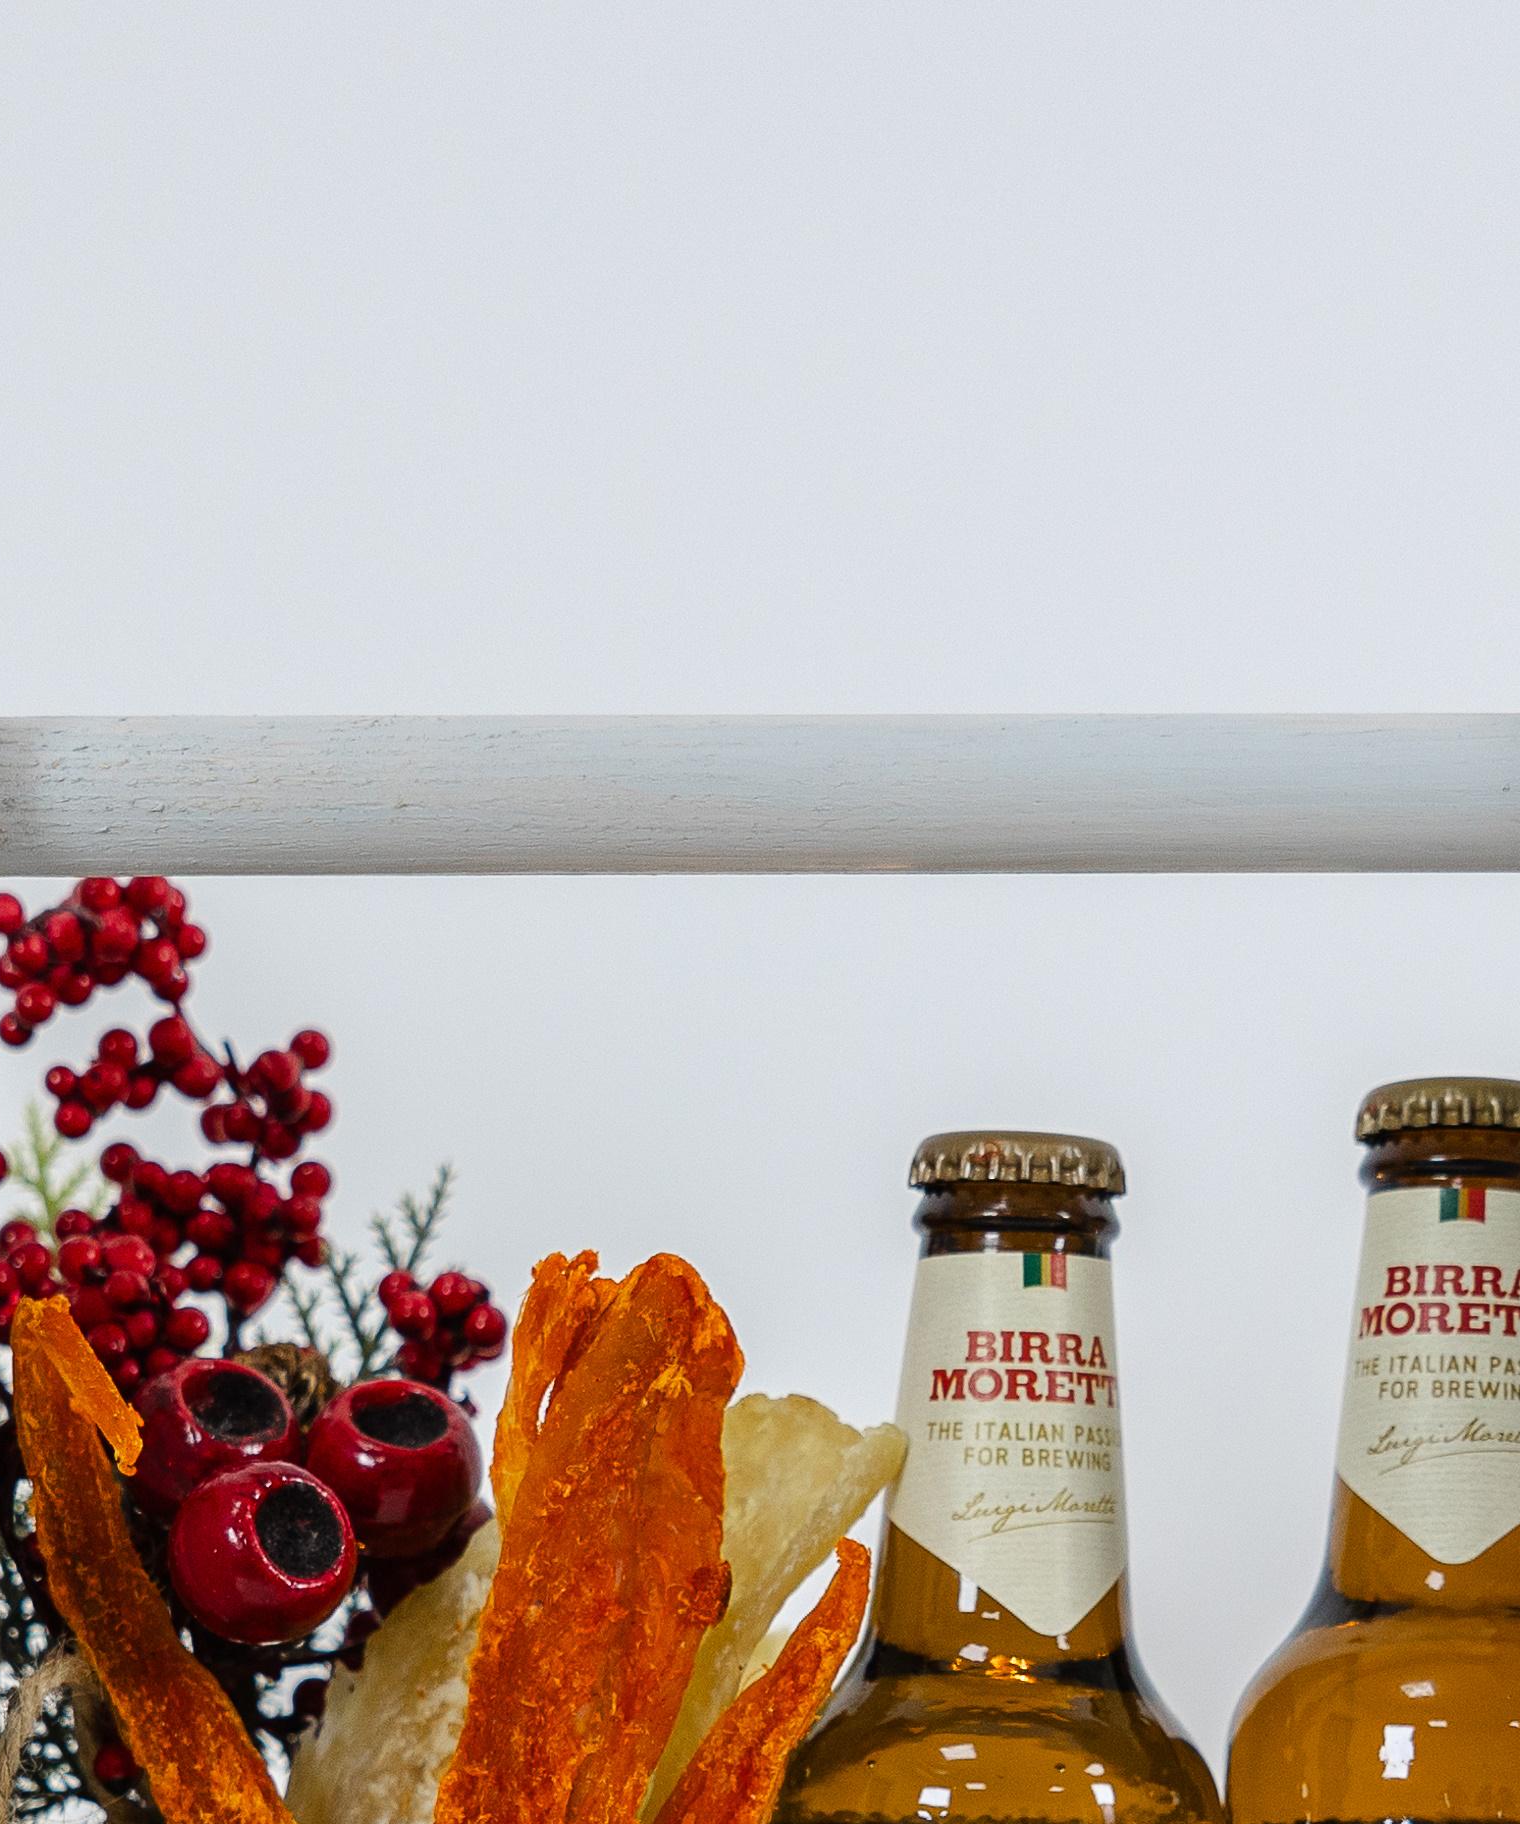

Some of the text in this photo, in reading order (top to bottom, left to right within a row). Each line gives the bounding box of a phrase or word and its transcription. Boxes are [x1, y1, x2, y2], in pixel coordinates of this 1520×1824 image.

[965, 1330, 1107, 1368] BIRRA
[1354, 1357, 1380, 1376] THE
[1389, 1355, 1477, 1375] ITALIAN
[929, 1368, 1117, 1408] MORETT
[1378, 1381, 1418, 1400] FOR
[927, 1421, 963, 1441] THE
[975, 1422, 1065, 1442] ITALIAN
[1367, 1423, 1444, 1466] Luigi
[963, 1447, 1112, 1472] FOR BREWING
[951, 1491, 1031, 1534] Luigi
